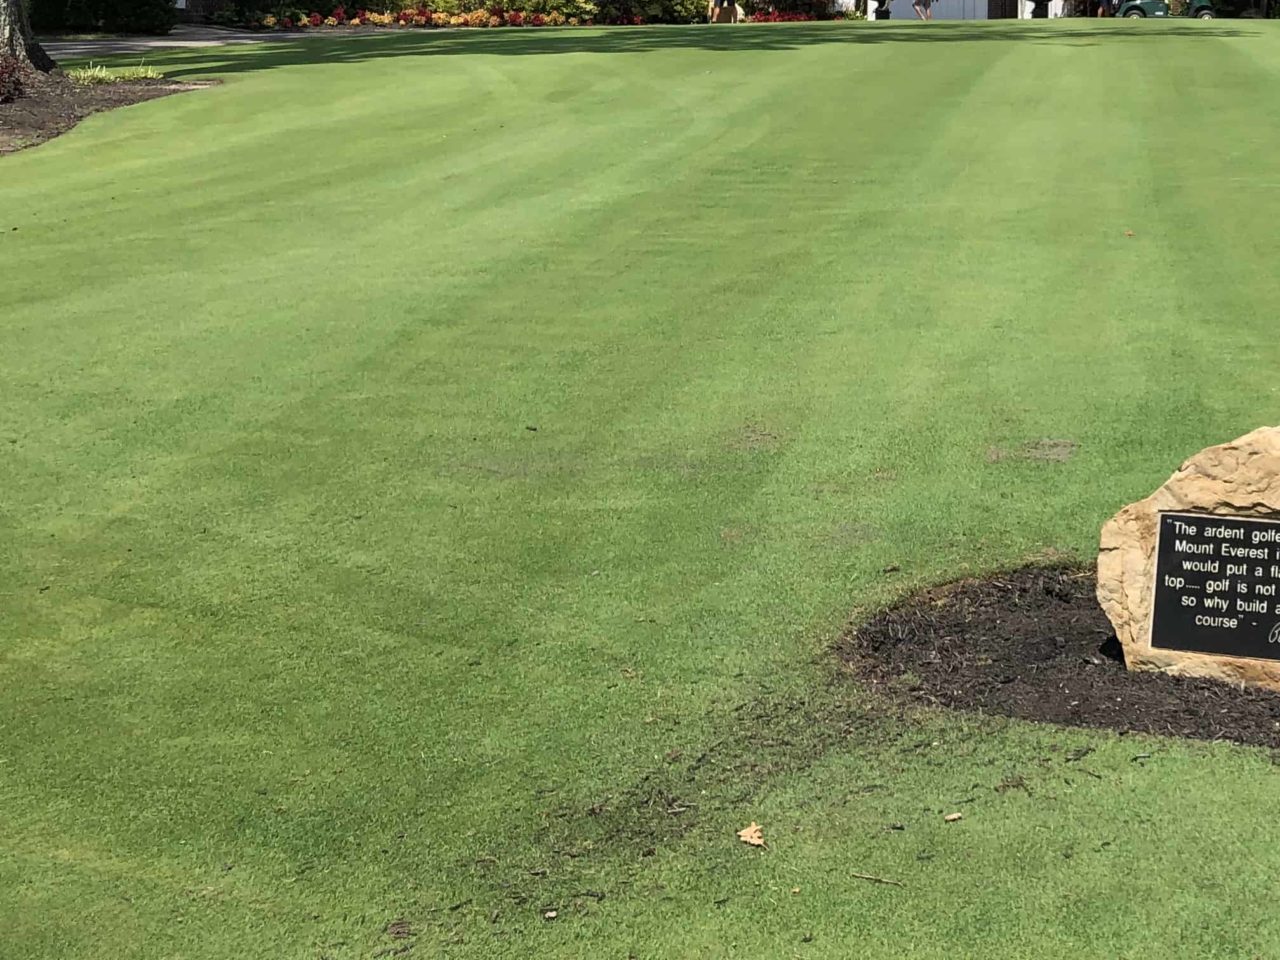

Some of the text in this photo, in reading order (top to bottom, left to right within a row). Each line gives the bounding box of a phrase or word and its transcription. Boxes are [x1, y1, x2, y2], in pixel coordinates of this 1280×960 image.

[1204, 525, 1244, 540] ardent
[1175, 539, 1214, 555] Mount
[1221, 543, 1268, 560] Everest
[1182, 559, 1219, 573] would
[1226, 563, 1247, 577] put
[1254, 566, 1263, 577] a
[1206, 579, 1230, 594] golf
[1237, 580, 1248, 593] is
[1255, 584, 1276, 596] not
[1181, 595, 1197, 607] so
[1203, 596, 1229, 612] why
[1236, 598, 1268, 614] build
